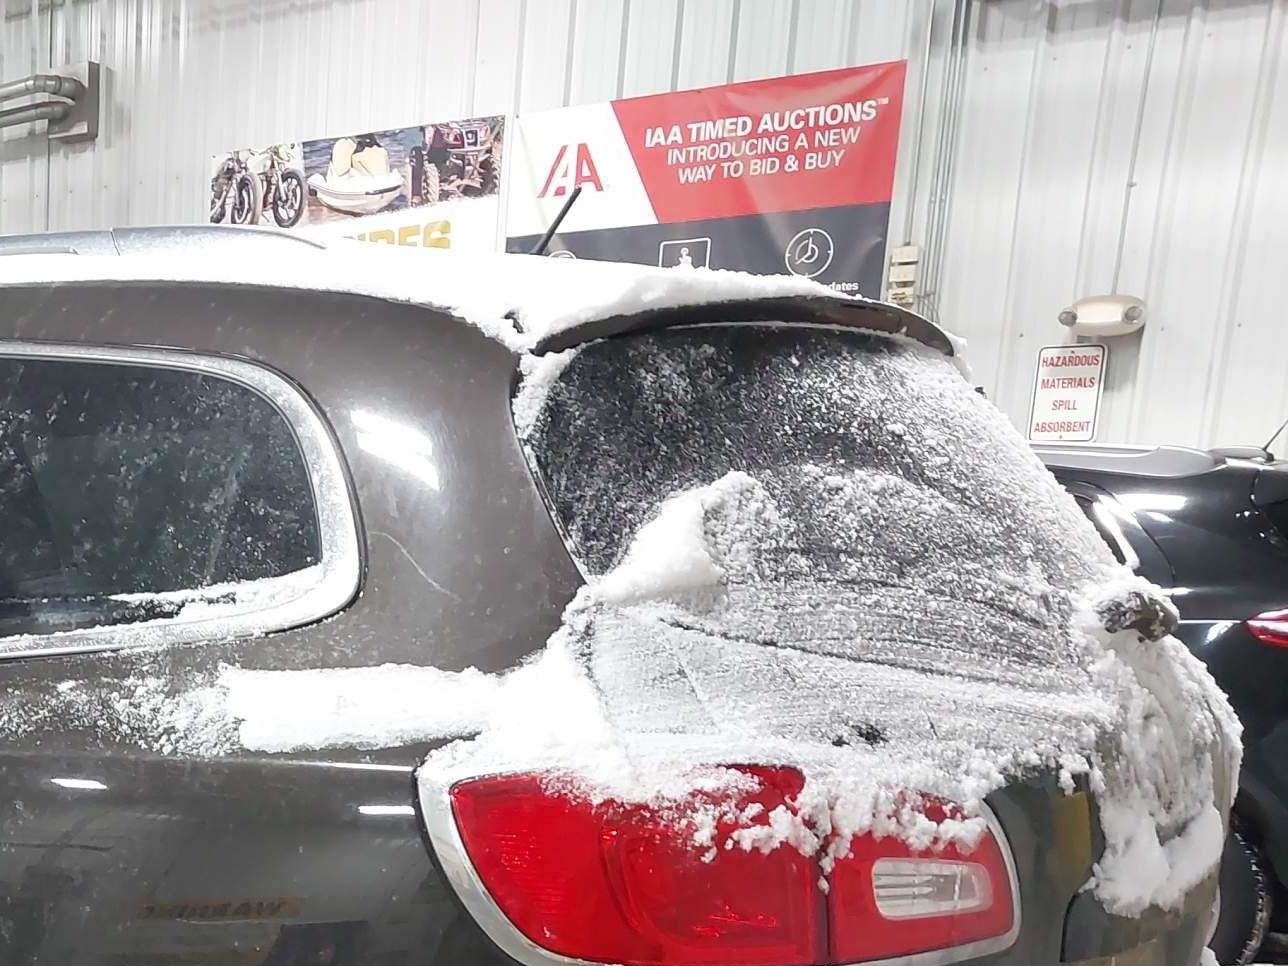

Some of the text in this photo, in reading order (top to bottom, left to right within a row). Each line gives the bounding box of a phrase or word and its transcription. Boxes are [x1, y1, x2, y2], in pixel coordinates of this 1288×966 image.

[645, 125, 683, 148] IAA
[687, 115, 753, 143] TIMED
[667, 126, 861, 166] INTRODUCING A NEW
[678, 149, 845, 184] WAY TO BID & BUY
[1041, 354, 1101, 368] HAZARDOUS
[1040, 376, 1096, 390] MATERIALS
[1051, 399, 1078, 411] SPILL
[1033, 420, 1092, 433] ABSORBENT
